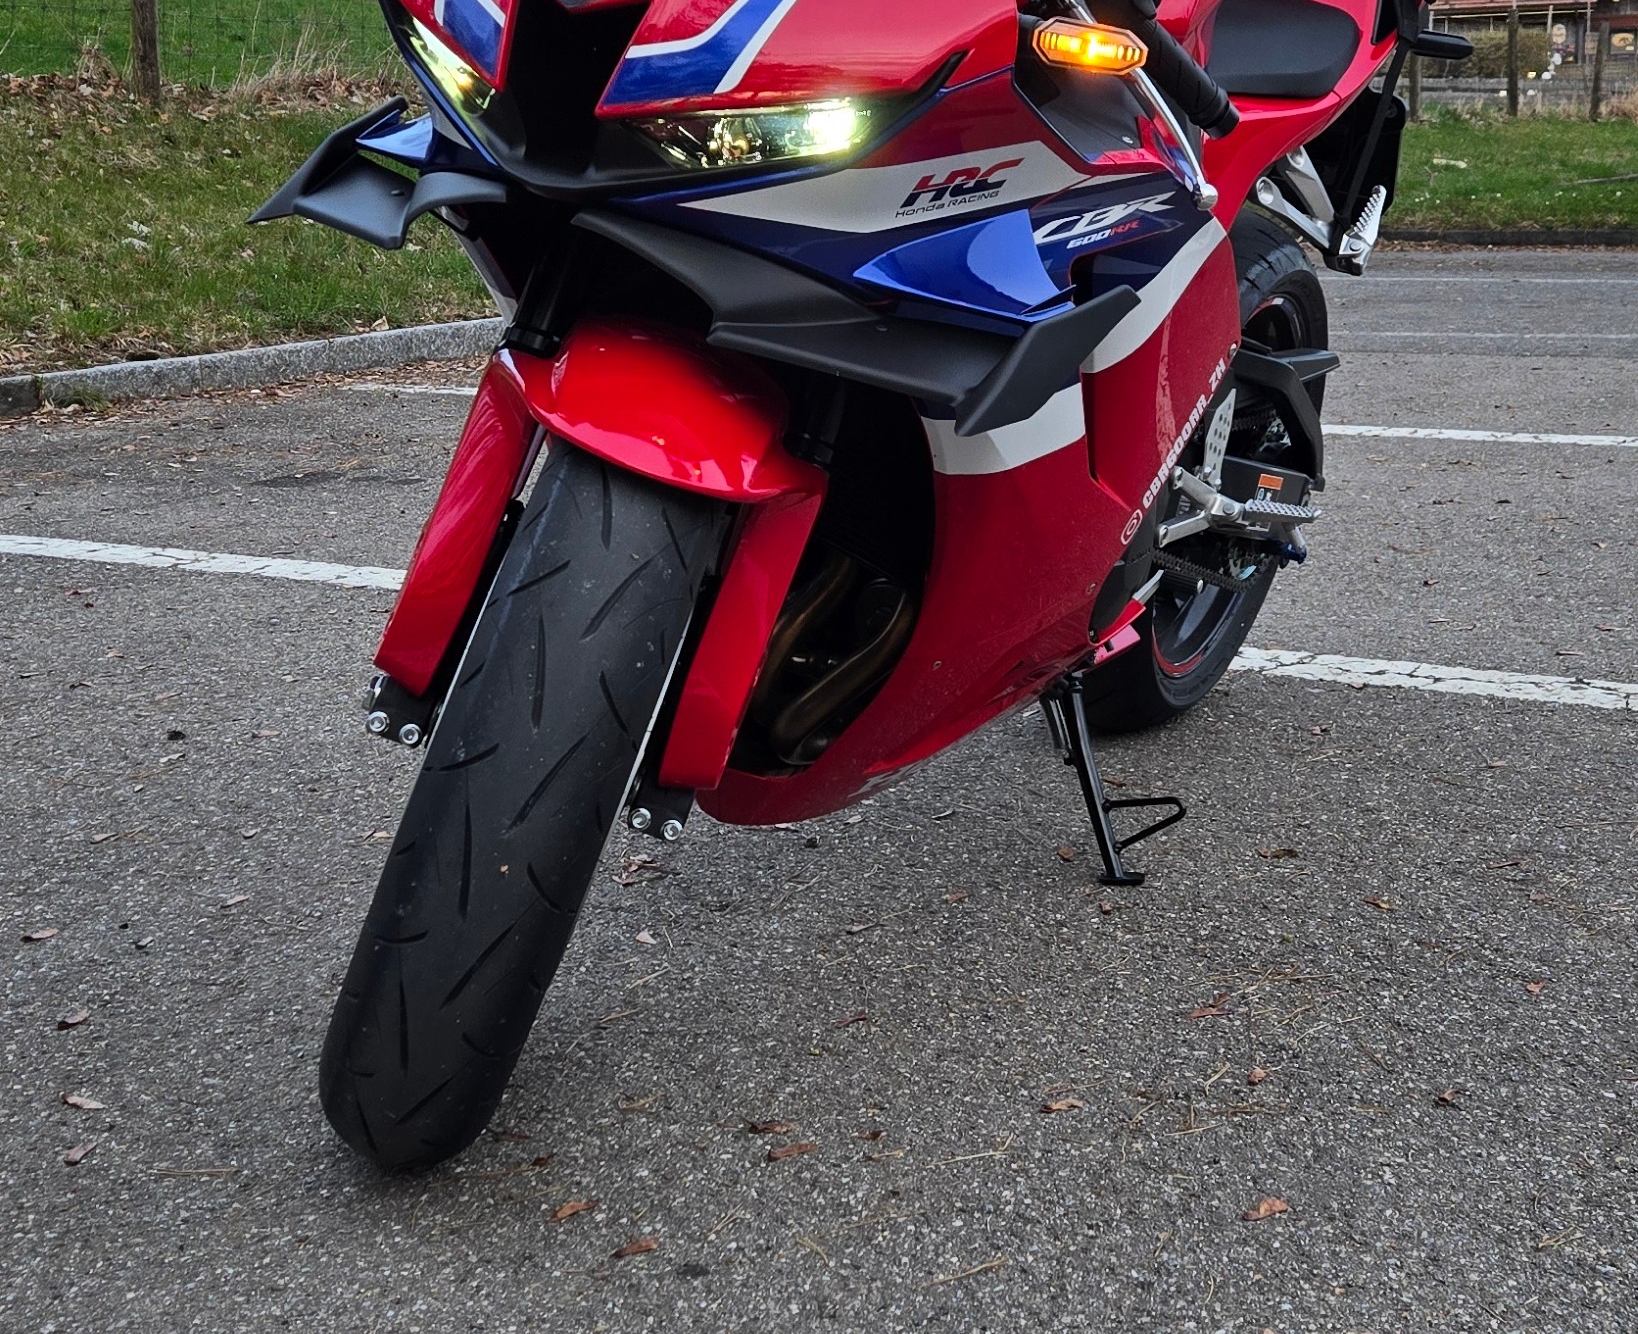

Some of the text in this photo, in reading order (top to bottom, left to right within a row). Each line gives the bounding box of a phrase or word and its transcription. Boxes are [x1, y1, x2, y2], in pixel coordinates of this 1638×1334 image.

[895, 190, 1000, 218] Honda RACING
[900, 157, 1025, 208] HRC
[1033, 191, 1176, 244] CBR
[1067, 219, 1140, 249] 600RR
[1142, 358, 1226, 509] CBR600RR_ZH
